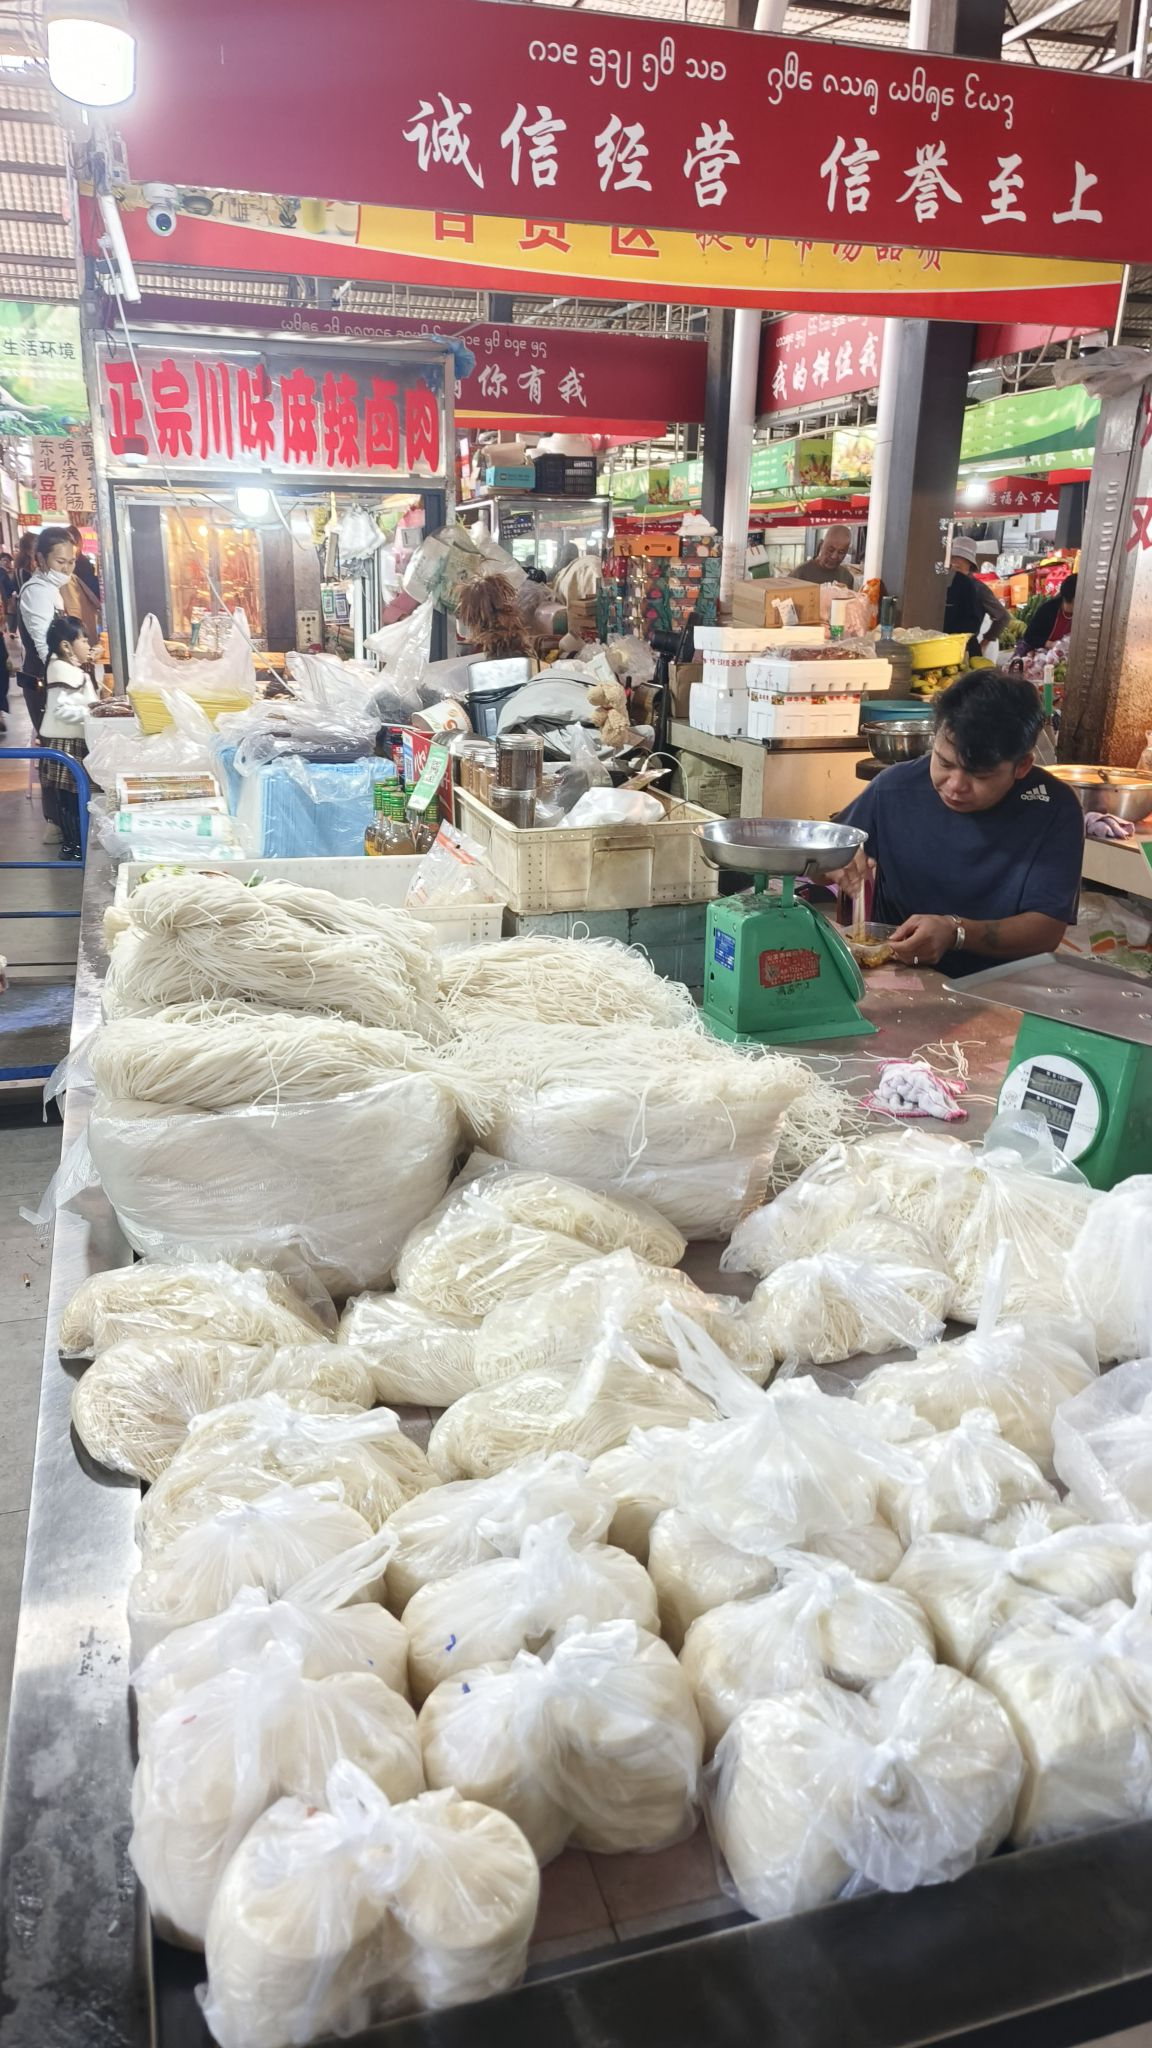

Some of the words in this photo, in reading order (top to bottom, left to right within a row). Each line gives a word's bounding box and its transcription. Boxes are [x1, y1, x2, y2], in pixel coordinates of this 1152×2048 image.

[403, 92, 742, 208] 诚信经营
[820, 135, 1104, 224] 信誉至上
[3, 338, 76, 360] 生活环境
[454, 363, 588, 408] 你有我
[104, 357, 441, 472] 正宗川味麻辣卤肉
[39, 438, 57, 511] 东北豆腐
[58, 438, 84, 511] 哈尔滨红肠
